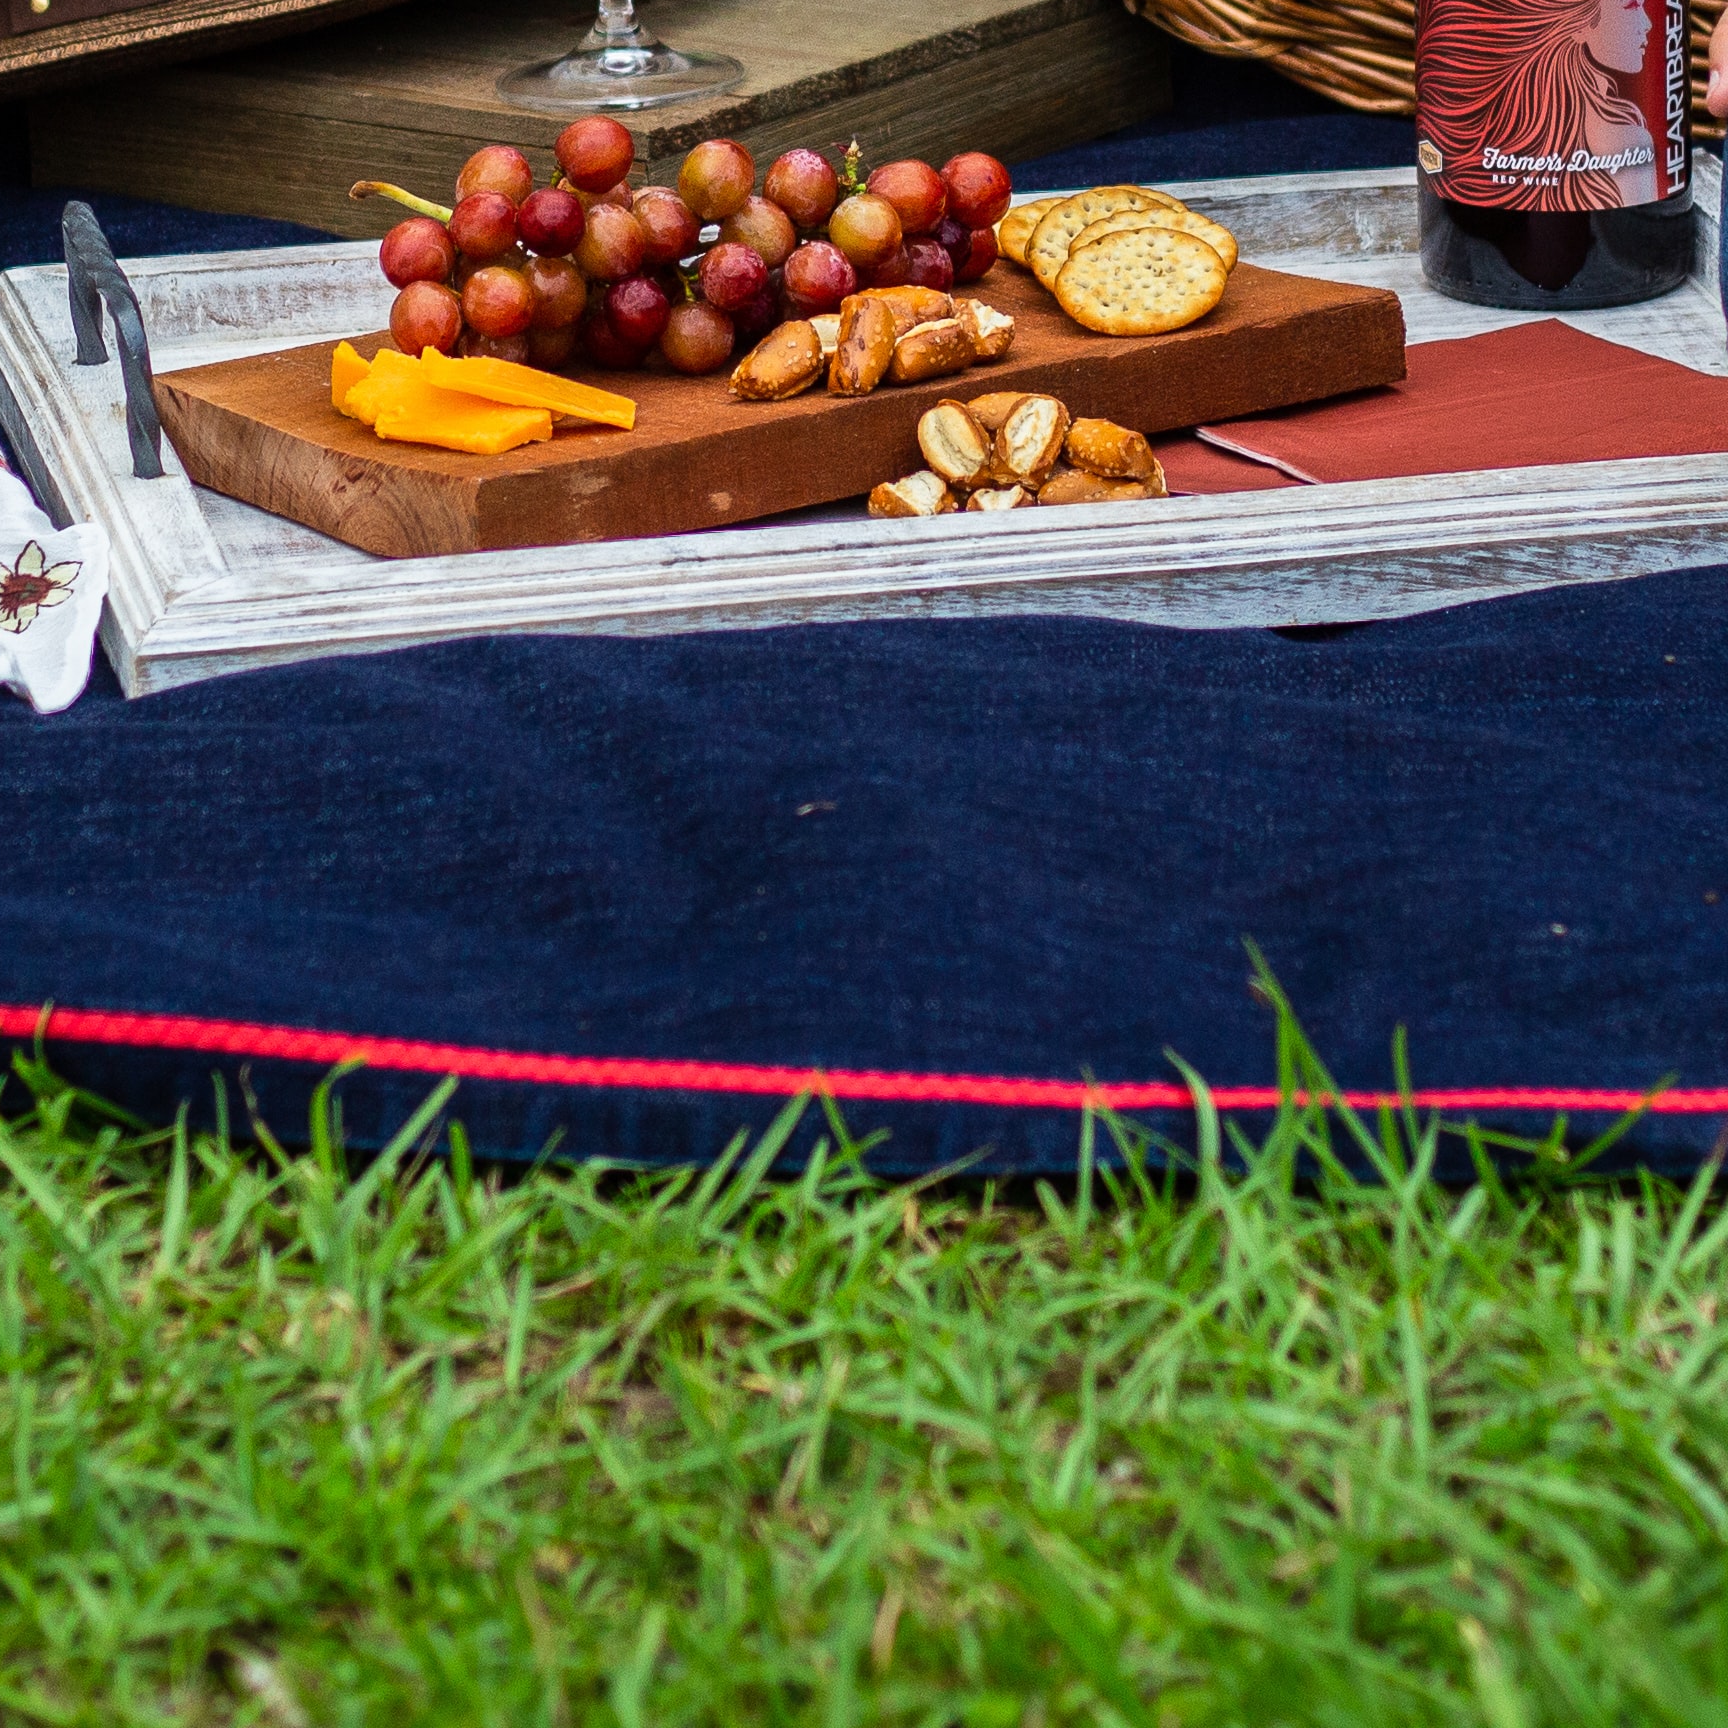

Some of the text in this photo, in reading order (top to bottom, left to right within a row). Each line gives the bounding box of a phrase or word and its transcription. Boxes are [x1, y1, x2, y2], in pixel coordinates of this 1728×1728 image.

[1482, 146, 1655, 174] Farmer's Daughter
[1492, 174, 1559, 186] RED WINE
